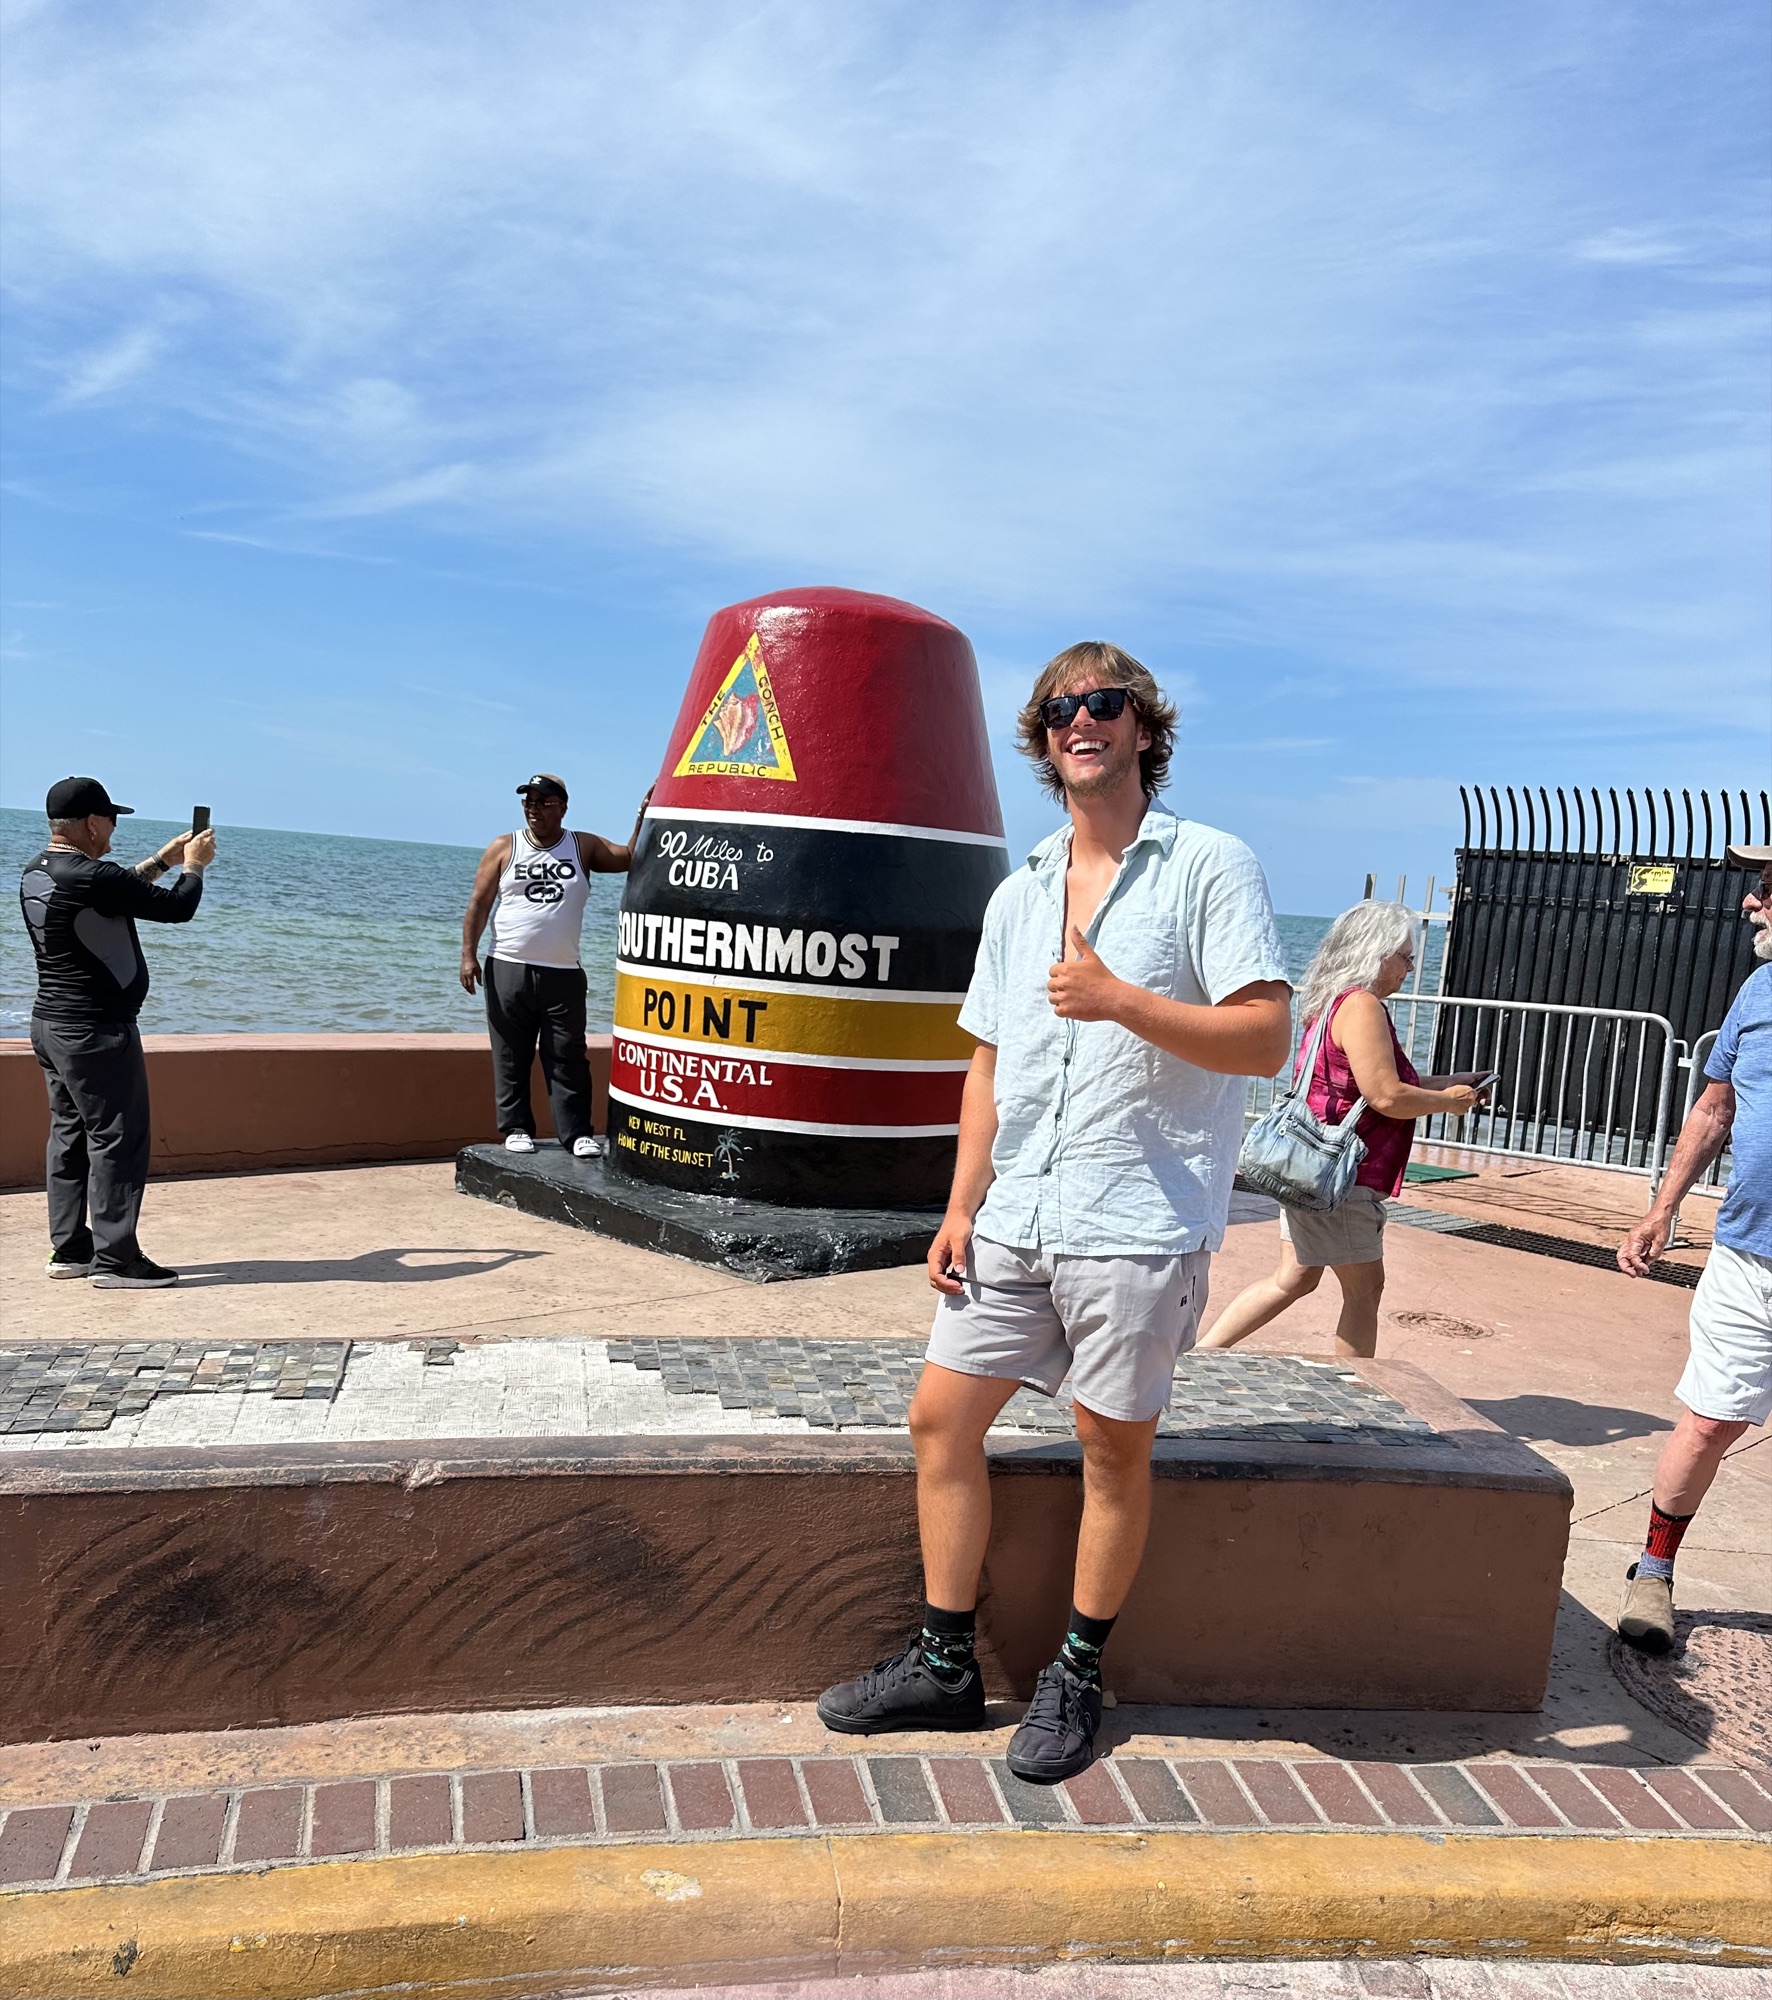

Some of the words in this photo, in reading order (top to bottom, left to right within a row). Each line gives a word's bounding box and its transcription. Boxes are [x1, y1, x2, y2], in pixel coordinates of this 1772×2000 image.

[700, 690, 725, 727] THE
[758, 676, 783, 740] CONCH
[688, 763, 767, 776] REPUBLIC
[657, 830, 687, 858] 90
[682, 835, 743, 861] Miles
[756, 842, 774, 862] to
[668, 859, 739, 891] CUBA
[644, 987, 767, 1042] POINT
[618, 1042, 773, 1086] CONTINENTAL
[640, 1069, 728, 1111] U.S.A.
[628, 1115, 641, 1130] KEY
[644, 1120, 671, 1137] WEST
[673, 1127, 687, 1141] FL
[617, 1132, 637, 1151] HOME
[640, 1140, 651, 1155] OF
[651, 1143, 671, 1160] THE
[671, 1148, 714, 1168] SUNSET
